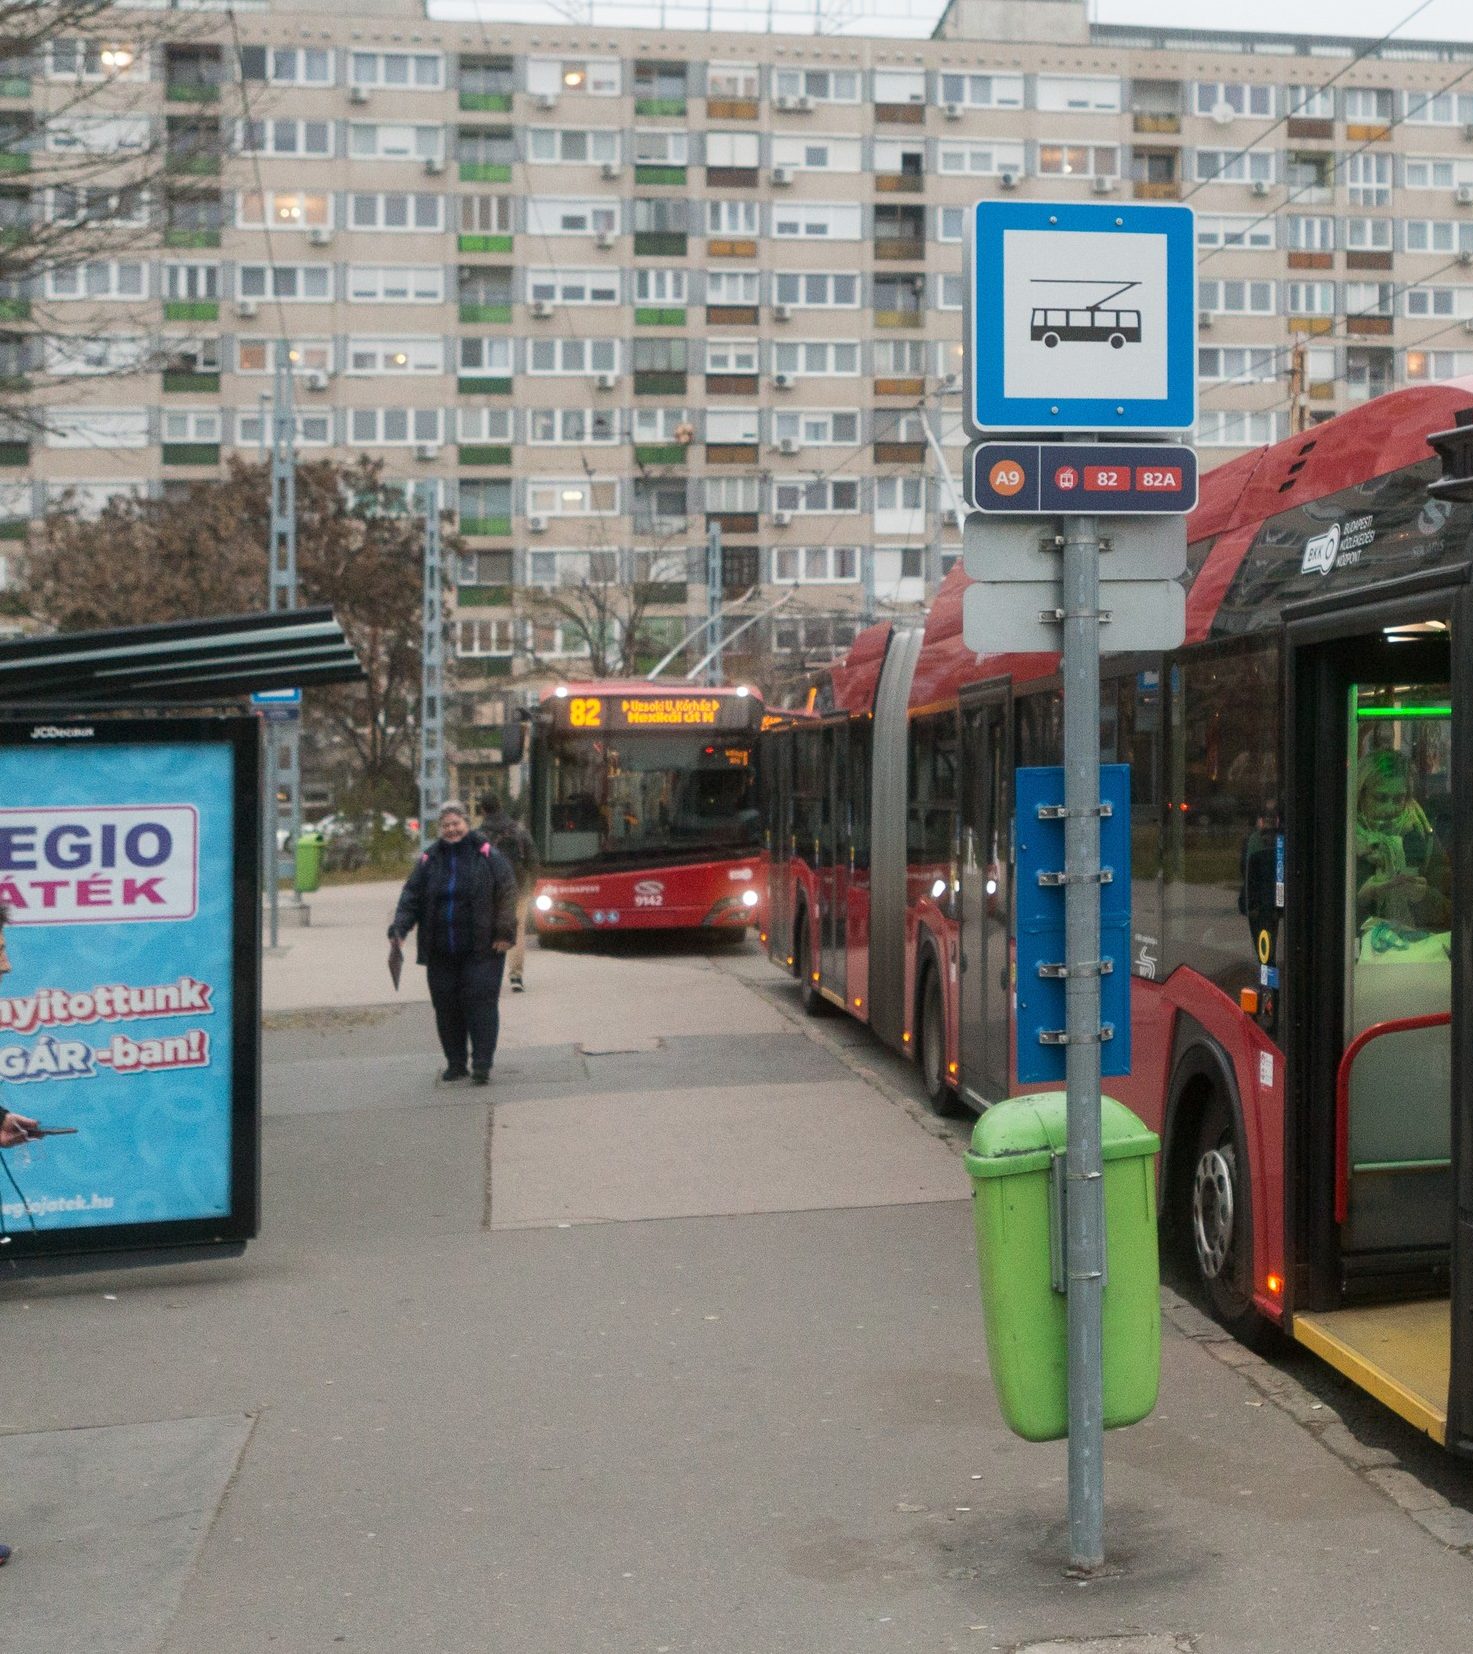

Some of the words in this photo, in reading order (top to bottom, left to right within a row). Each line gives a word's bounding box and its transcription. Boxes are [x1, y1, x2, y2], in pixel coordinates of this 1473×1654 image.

[995, 471, 1020, 486] A9
[1097, 472, 1118, 486] 82
[1143, 473, 1176, 487] 82A
[569, 698, 600, 727] 82
[630, 699, 664, 712] Uzsoki
